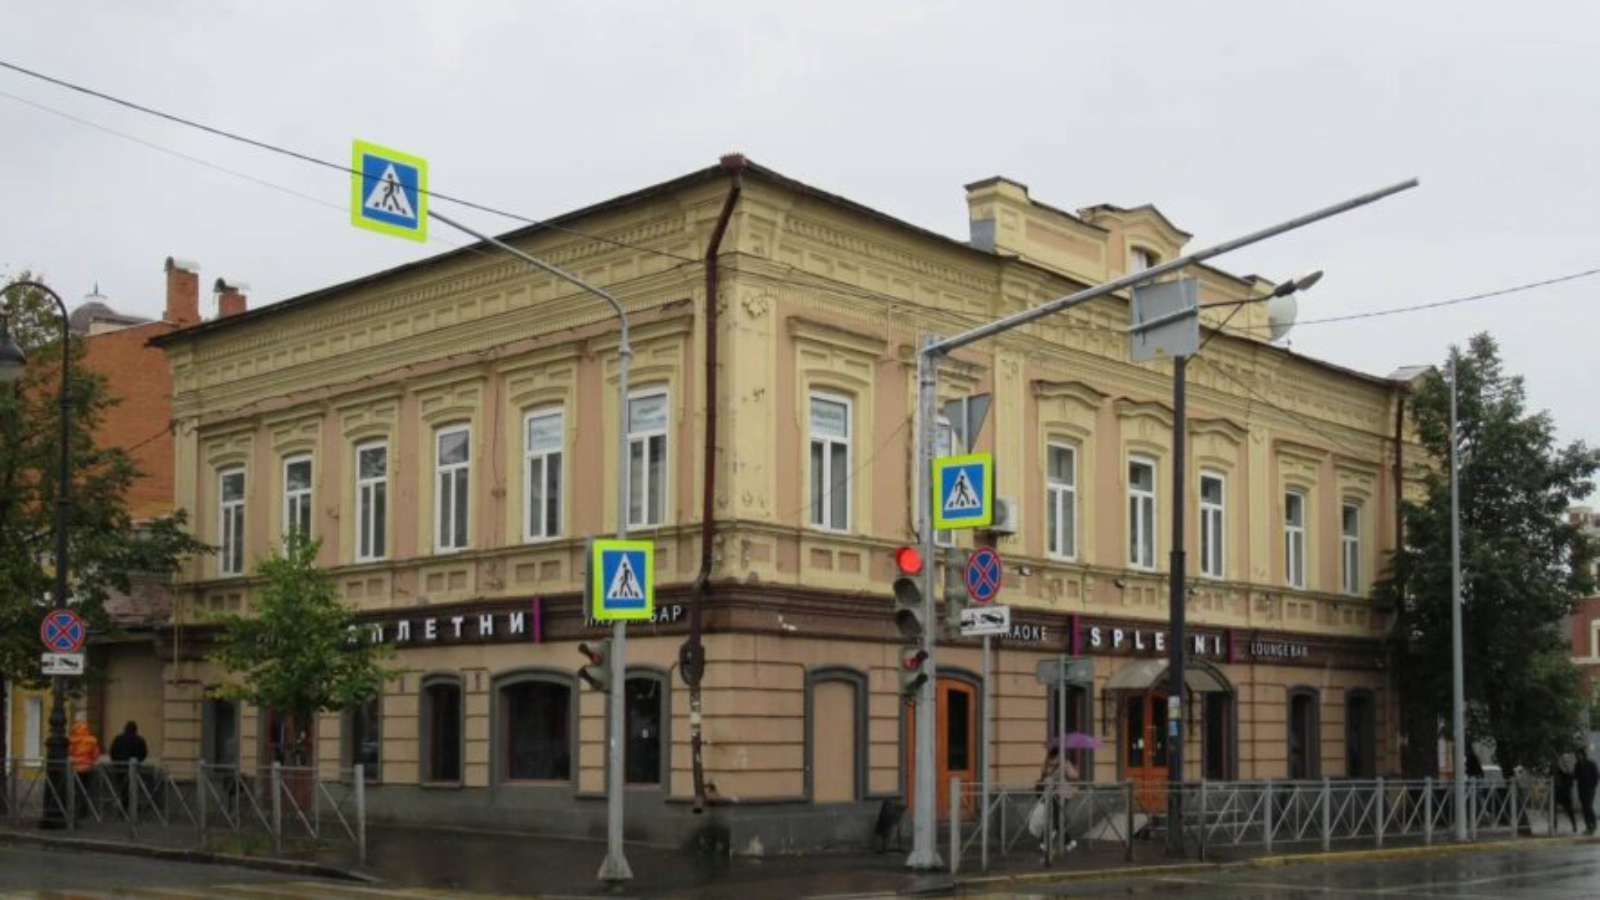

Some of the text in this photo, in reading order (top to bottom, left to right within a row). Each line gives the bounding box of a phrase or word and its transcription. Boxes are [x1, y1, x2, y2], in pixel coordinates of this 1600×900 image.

[990, 624, 1048, 641] AOKE
[1090, 627, 1220, 655] SPLENI
[1250, 642, 1289, 656] LOUNGE
